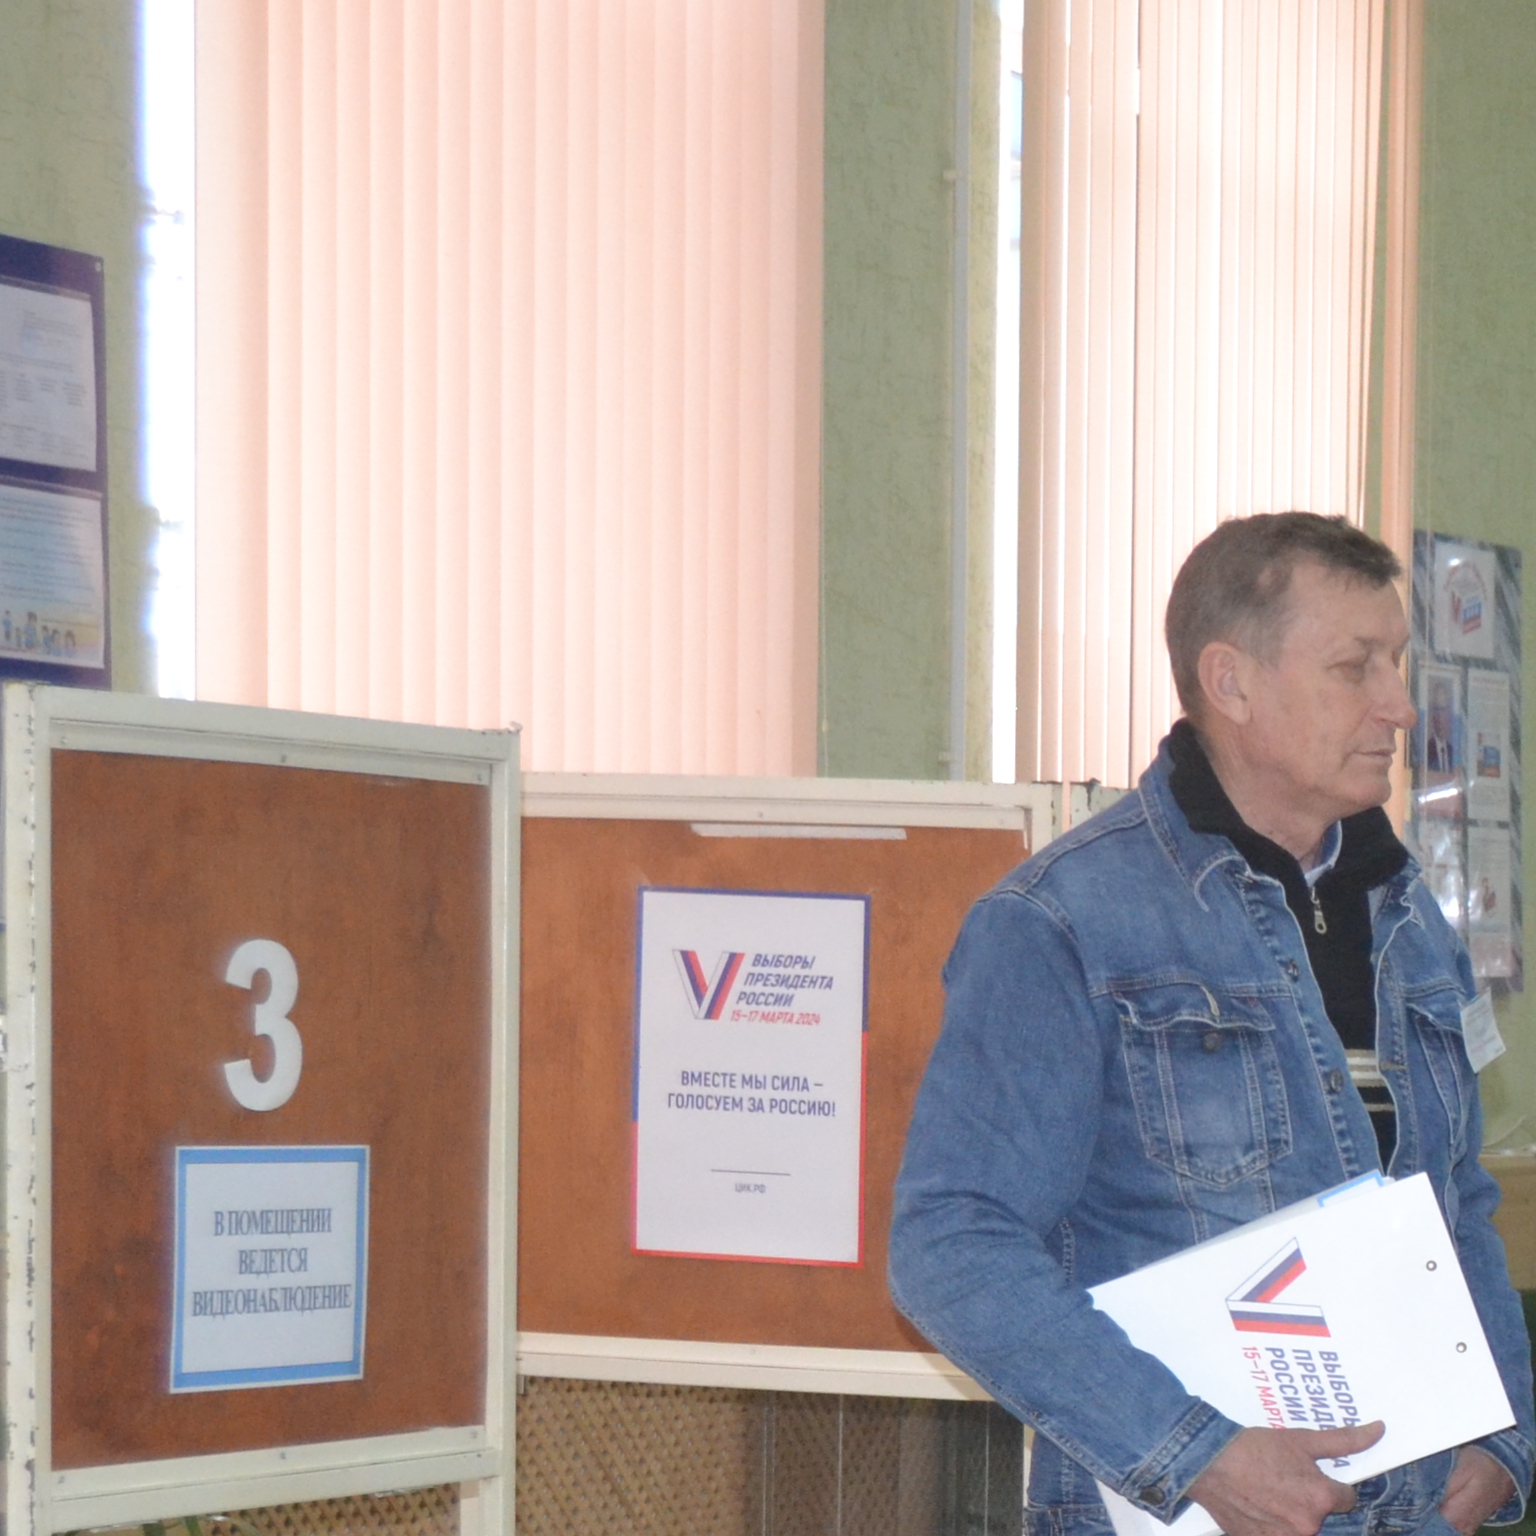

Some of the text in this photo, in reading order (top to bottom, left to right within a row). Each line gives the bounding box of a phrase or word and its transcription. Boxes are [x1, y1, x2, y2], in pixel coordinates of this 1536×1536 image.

[751, 953, 816, 970] ВЫБОРЫ
[743, 972, 834, 991] ПРЕЗИДЕНТА
[736, 991, 795, 1007] РОССИИ
[223, 938, 303, 1112] 3
[759, 1010, 794, 1024] МАРТА
[795, 1012, 821, 1026] 2024
[681, 1070, 737, 1089] ВМЕСТЕ
[741, 1074, 767, 1090] МЫ
[771, 1075, 810, 1092] СИЛА
[668, 1092, 836, 1117] ГОЛОСУЕМ ЗА РОССИЮ!
[735, 1182, 767, 1195] ЦИК.РФ
[214, 1208, 332, 1239] В ПОМЕЩЕНИИ
[237, 1246, 309, 1278] ВЕДЕТСЯ
[191, 1284, 352, 1319] ВИДЕОНАБЛЮДЕНИЕ
[1264, 1347, 1309, 1422] РОССИИ
